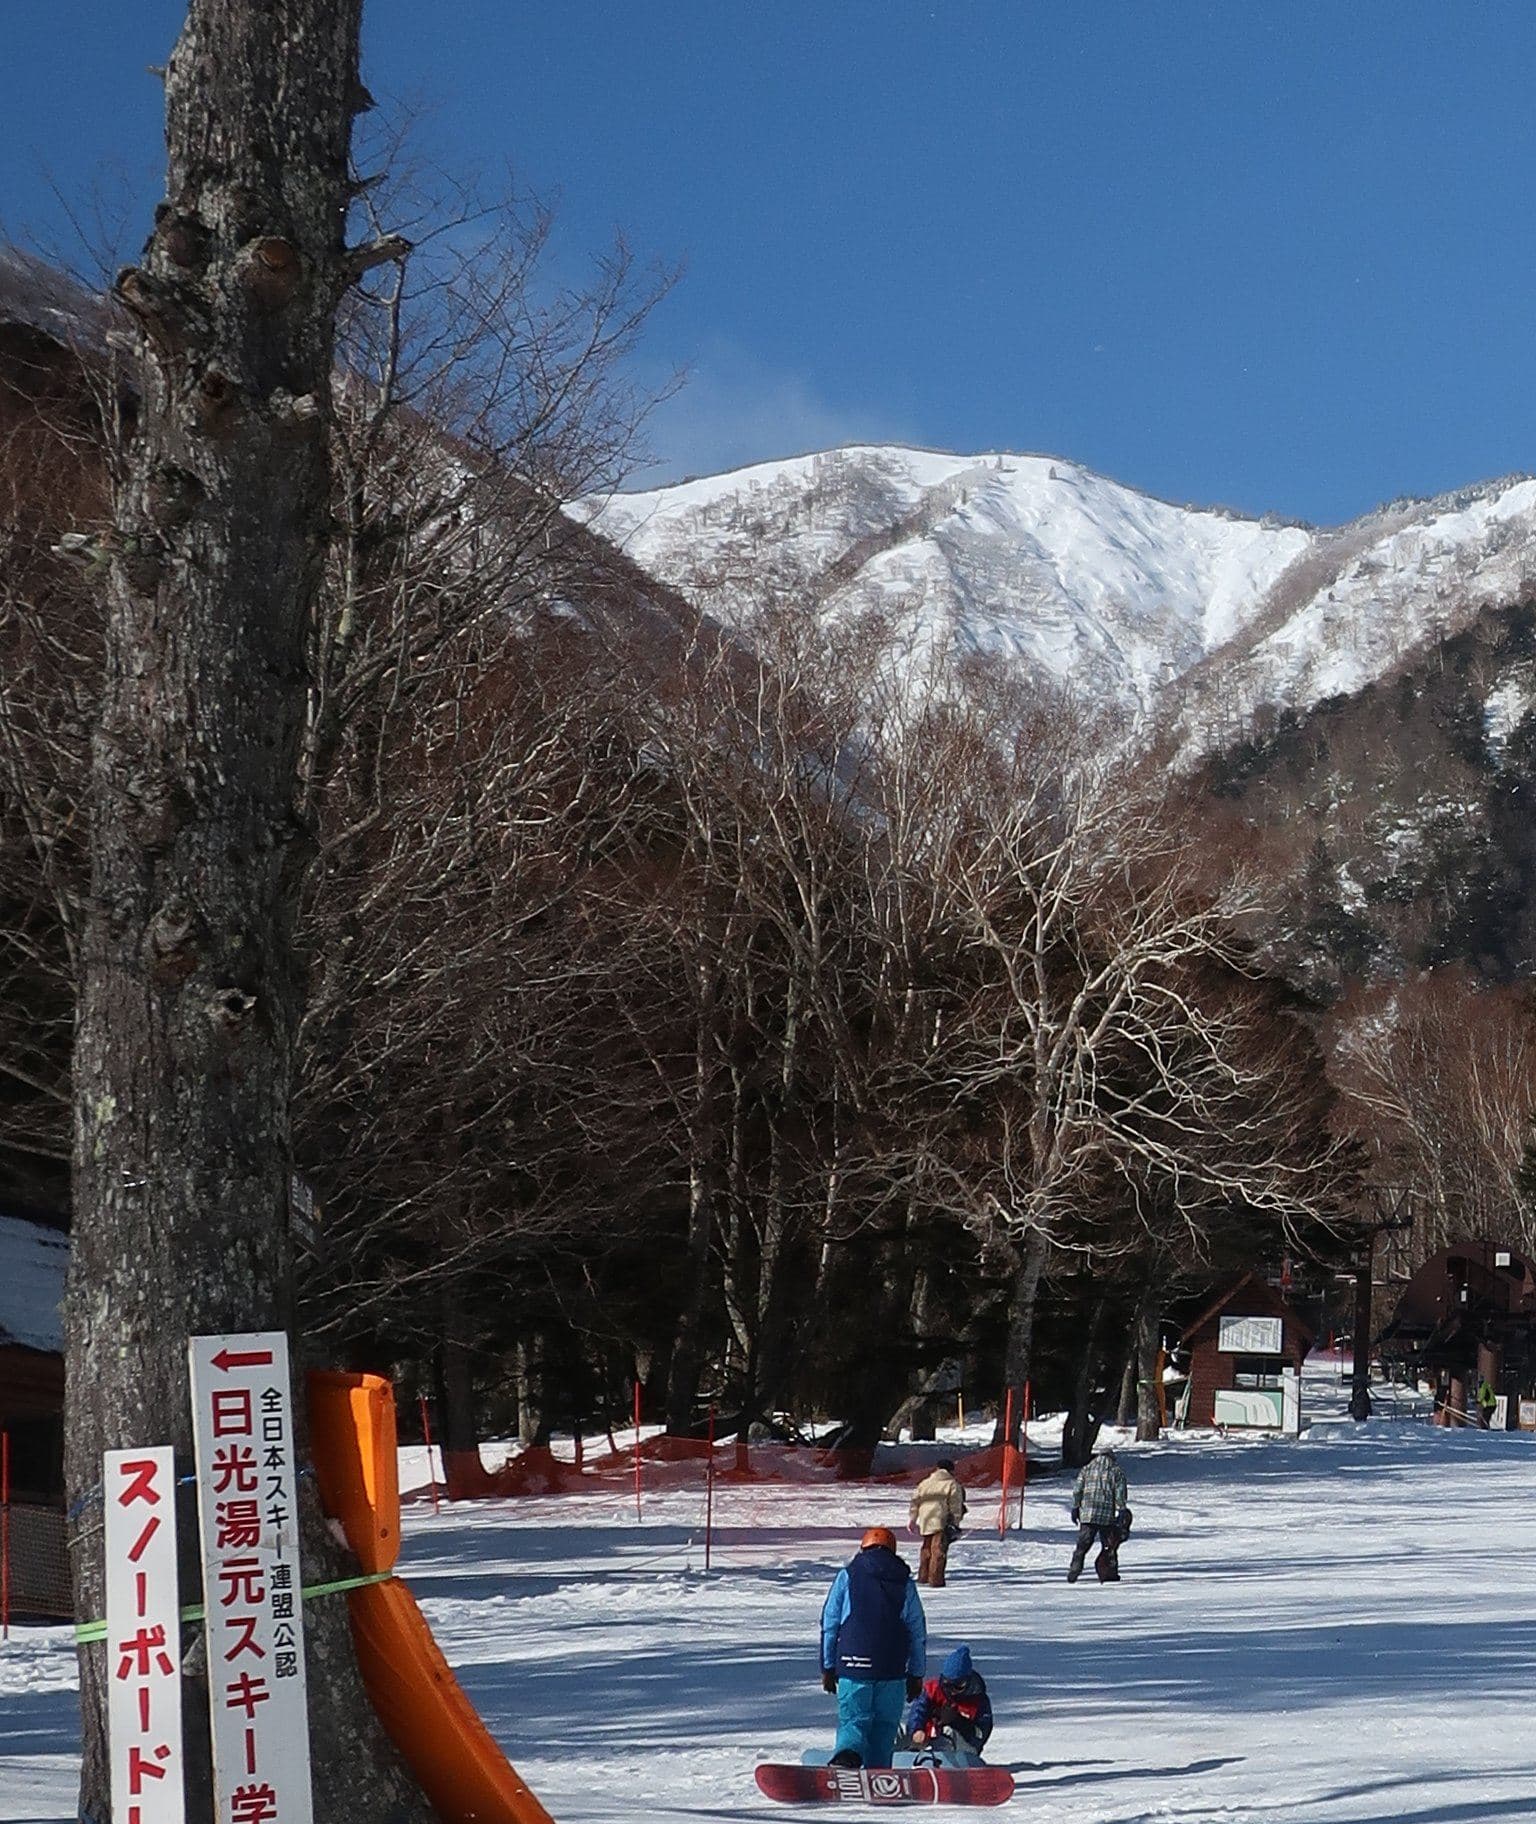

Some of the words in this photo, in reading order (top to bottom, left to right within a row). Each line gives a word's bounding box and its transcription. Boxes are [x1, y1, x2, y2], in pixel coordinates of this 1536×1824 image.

[260, 1387, 297, 1677] 全日本スキー連盟公認
